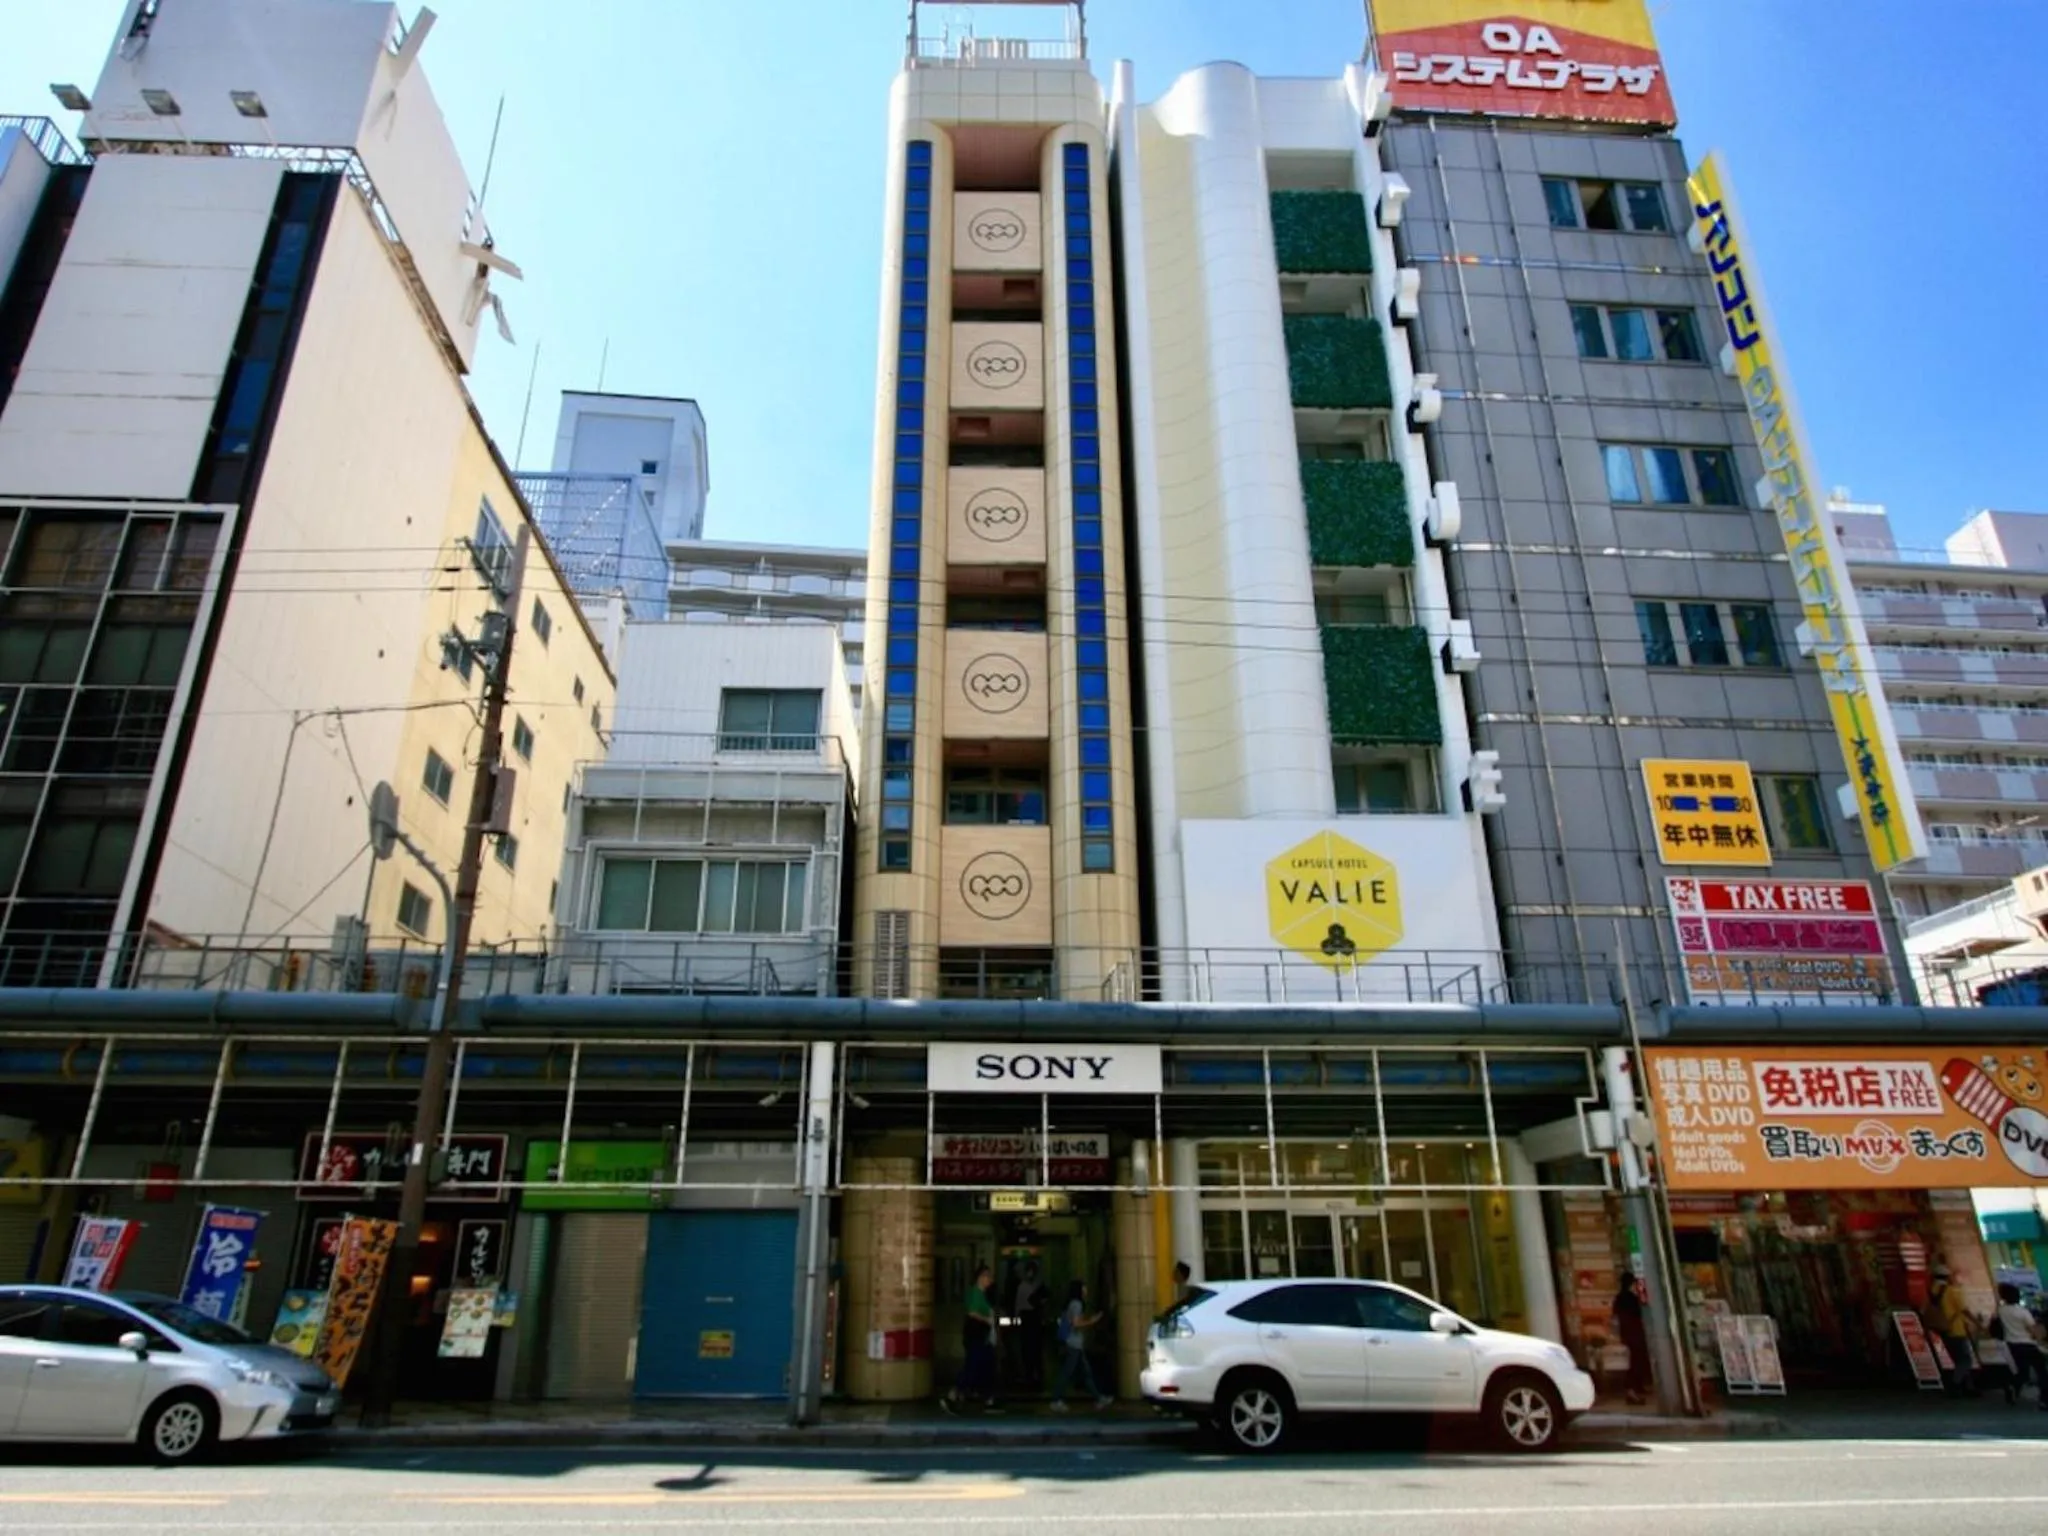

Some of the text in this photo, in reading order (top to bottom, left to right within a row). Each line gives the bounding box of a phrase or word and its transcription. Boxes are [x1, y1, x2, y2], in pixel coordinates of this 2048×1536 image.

[1481, 22, 1563, 55] OA
[1392, 51, 1660, 95] システムプラザ
[1663, 772, 1735, 790] 営業時間
[1662, 823, 1760, 849] 年中無休
[1291, 858, 1368, 869] CAPSULE HOTEL
[1280, 880, 1387, 904] VALIE
[1724, 885, 1848, 910] TAX FREE
[976, 1054, 1113, 1080] SONY
[1886, 1069, 1930, 1089] TAX
[1706, 1083, 1751, 1103] DVD
[1760, 1066, 1885, 1108] 免税店
[1890, 1089, 1939, 1108] FREE
[1710, 1106, 1755, 1126] DVD
